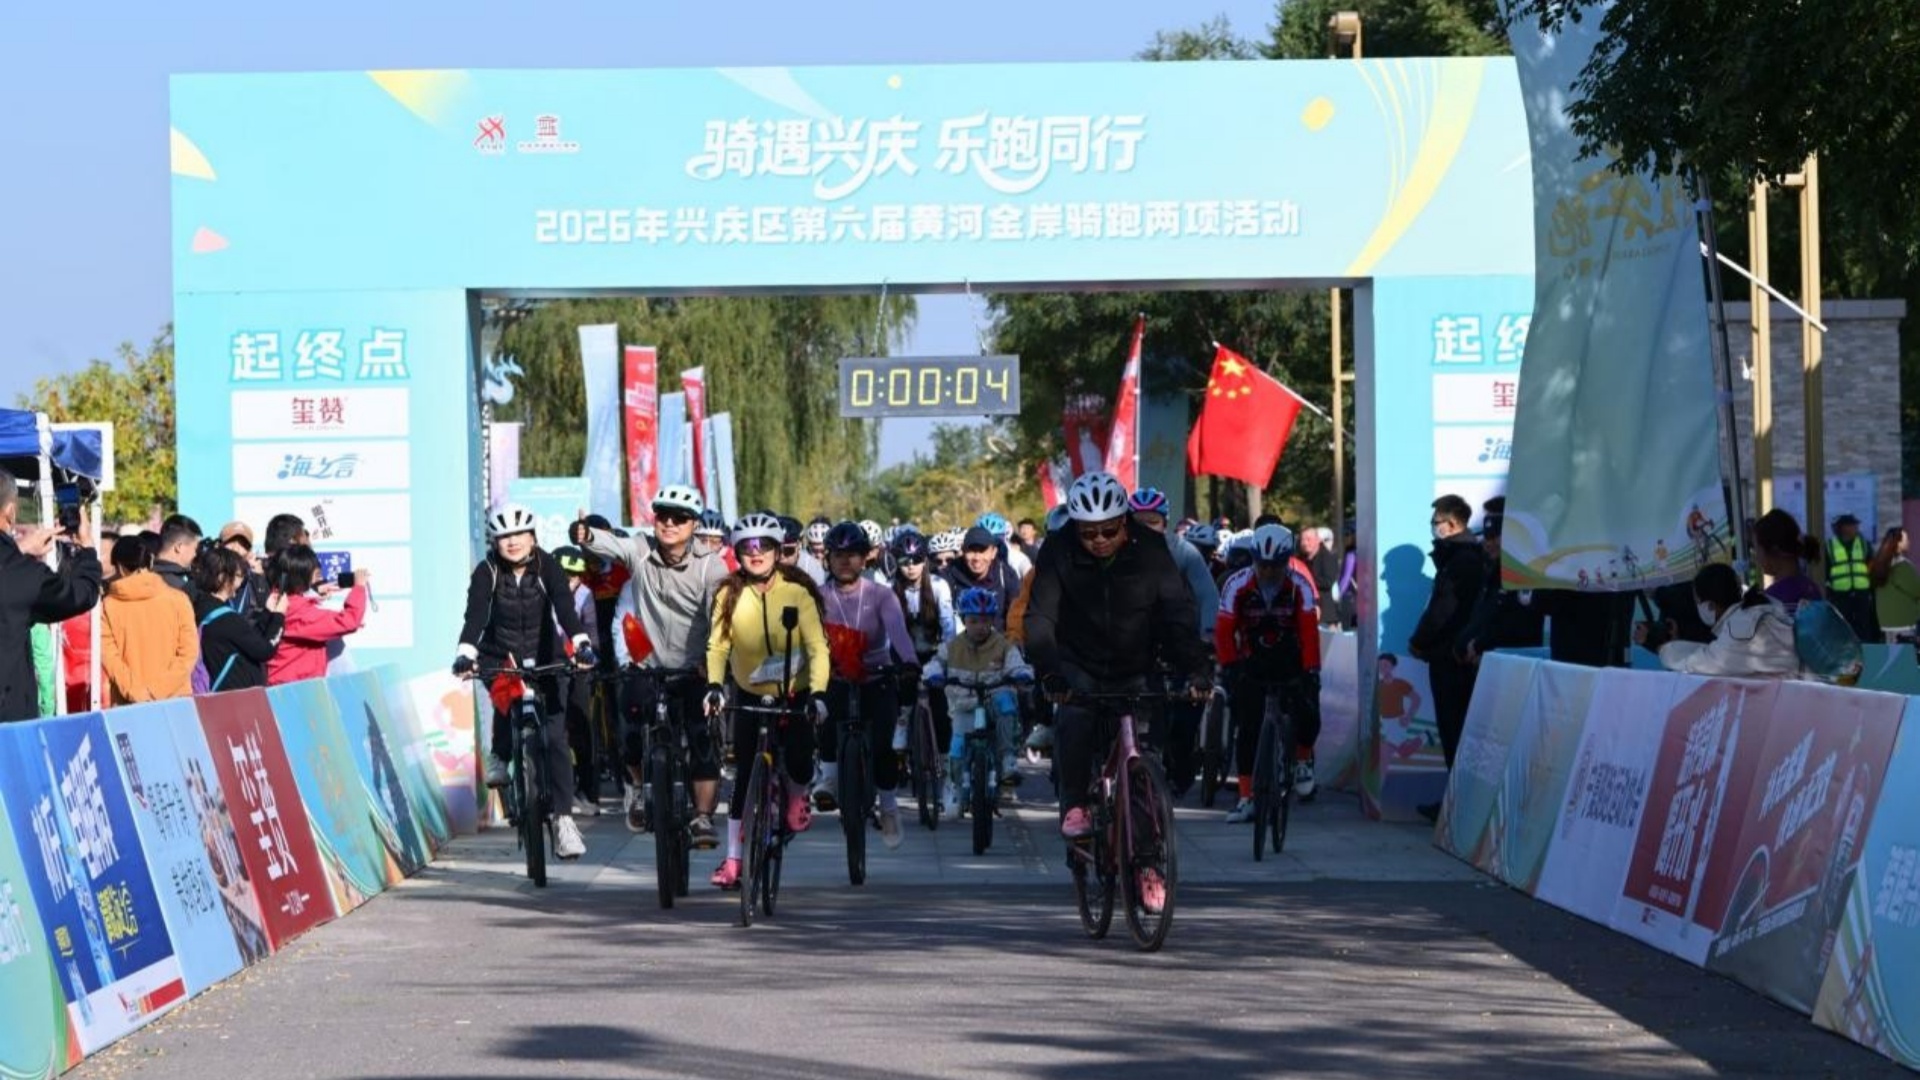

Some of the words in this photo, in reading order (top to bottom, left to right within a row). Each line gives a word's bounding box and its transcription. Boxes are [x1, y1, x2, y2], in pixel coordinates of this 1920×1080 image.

[687, 115, 920, 200] 骑遇兴庆
[936, 114, 1145, 193] 乐跑同行
[535, 200, 1300, 245] 2026年兴庆区第六届黄河金岸骑跑两项活动
[231, 328, 409, 382] 起终点
[850, 367, 1010, 407] 0:00:04
[292, 397, 345, 425] 玺赞
[277, 453, 359, 480] 海之言
